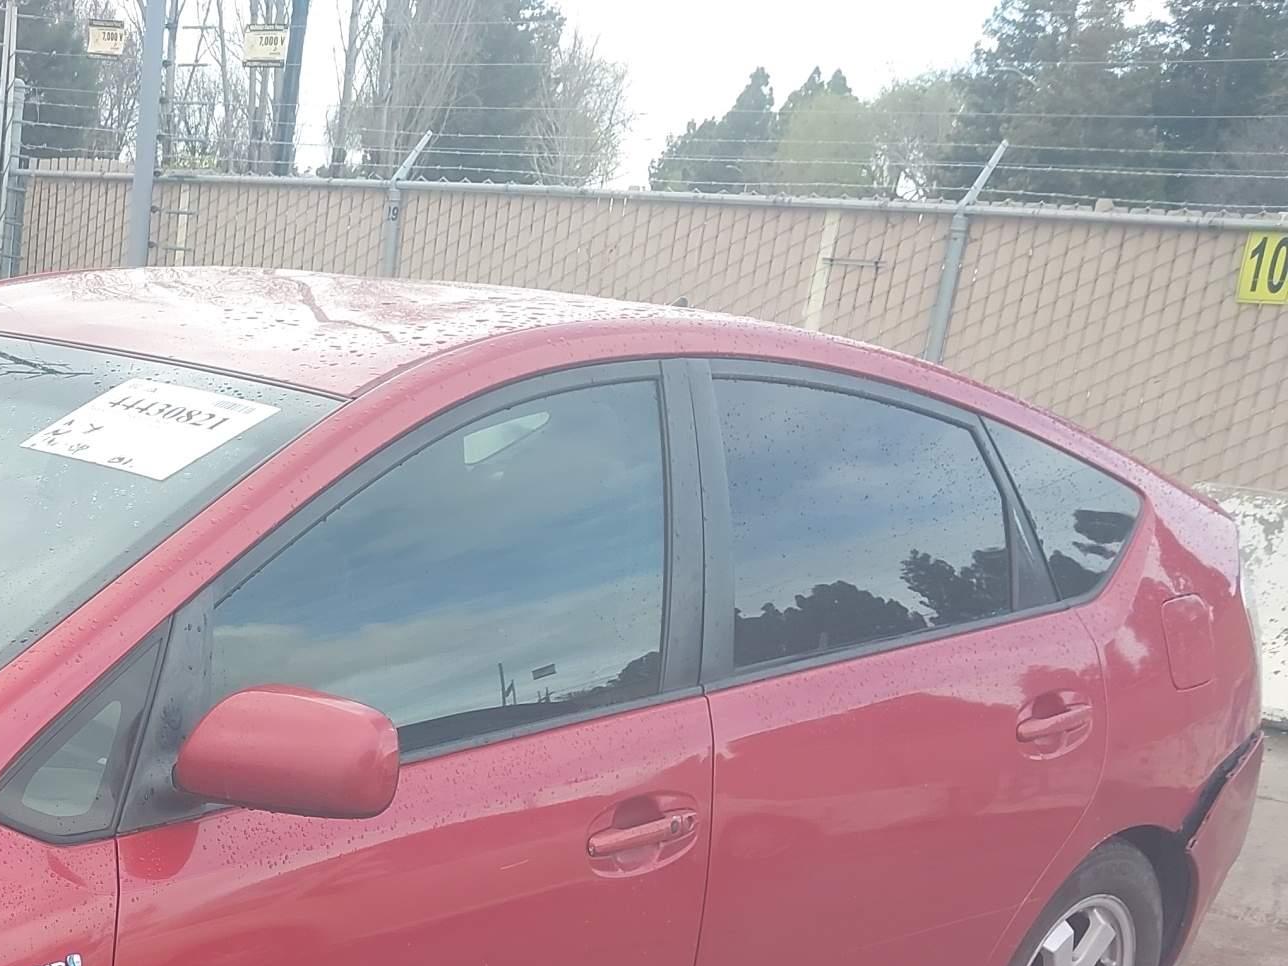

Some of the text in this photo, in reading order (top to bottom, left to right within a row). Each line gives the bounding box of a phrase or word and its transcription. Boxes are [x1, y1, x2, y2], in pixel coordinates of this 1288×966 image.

[103, 31, 118, 41] 7,000
[259, 35, 286, 46] 7,000 V
[1250, 236, 1288, 294] 10
[109, 396, 230, 430] 44430821
